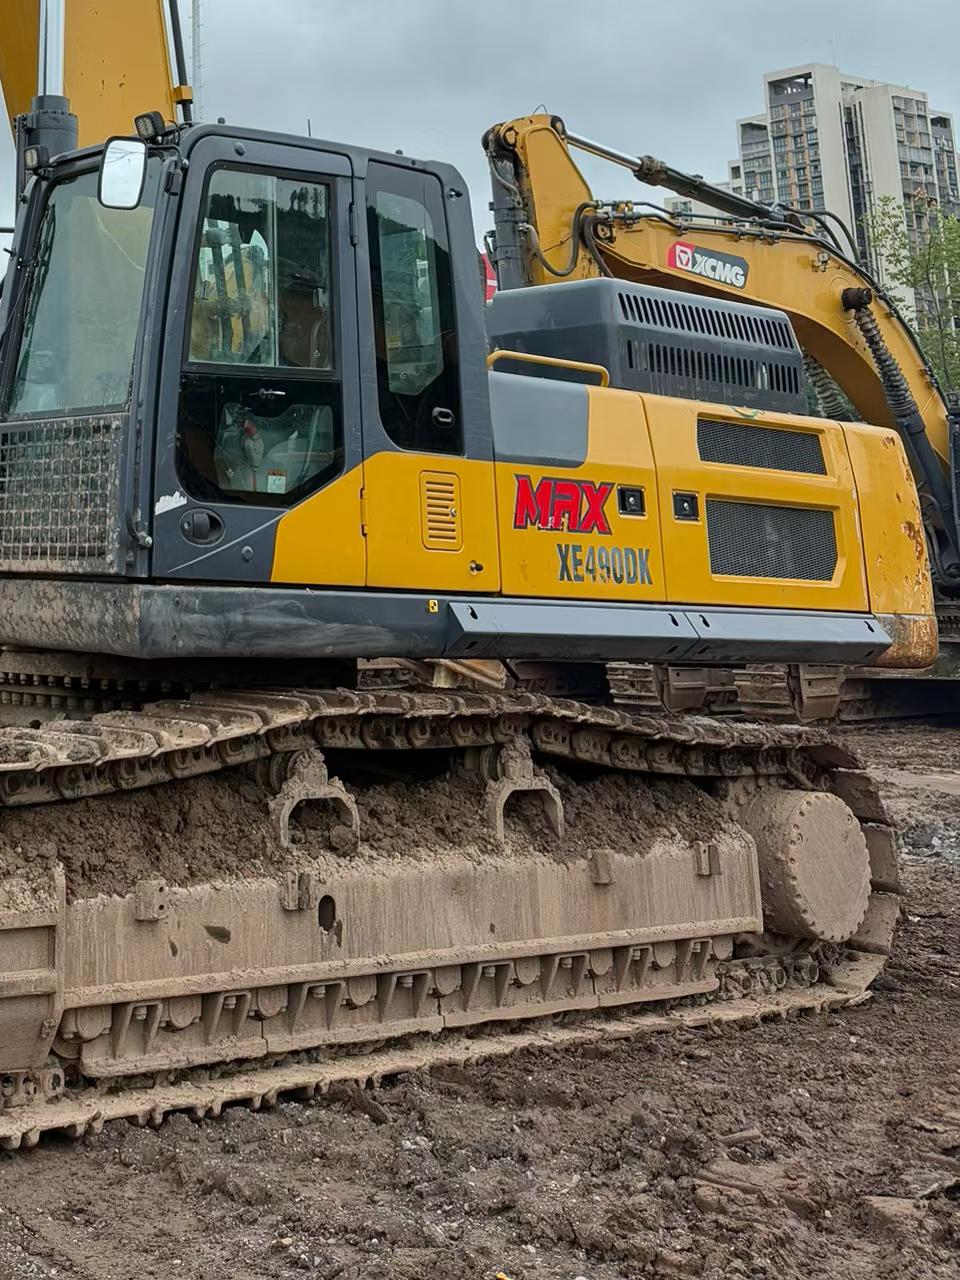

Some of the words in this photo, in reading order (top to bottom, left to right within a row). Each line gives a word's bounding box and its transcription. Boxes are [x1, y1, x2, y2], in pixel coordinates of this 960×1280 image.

[692, 253, 745, 287] XCMG
[513, 474, 615, 535] MAX
[557, 544, 652, 585] XE490DK
